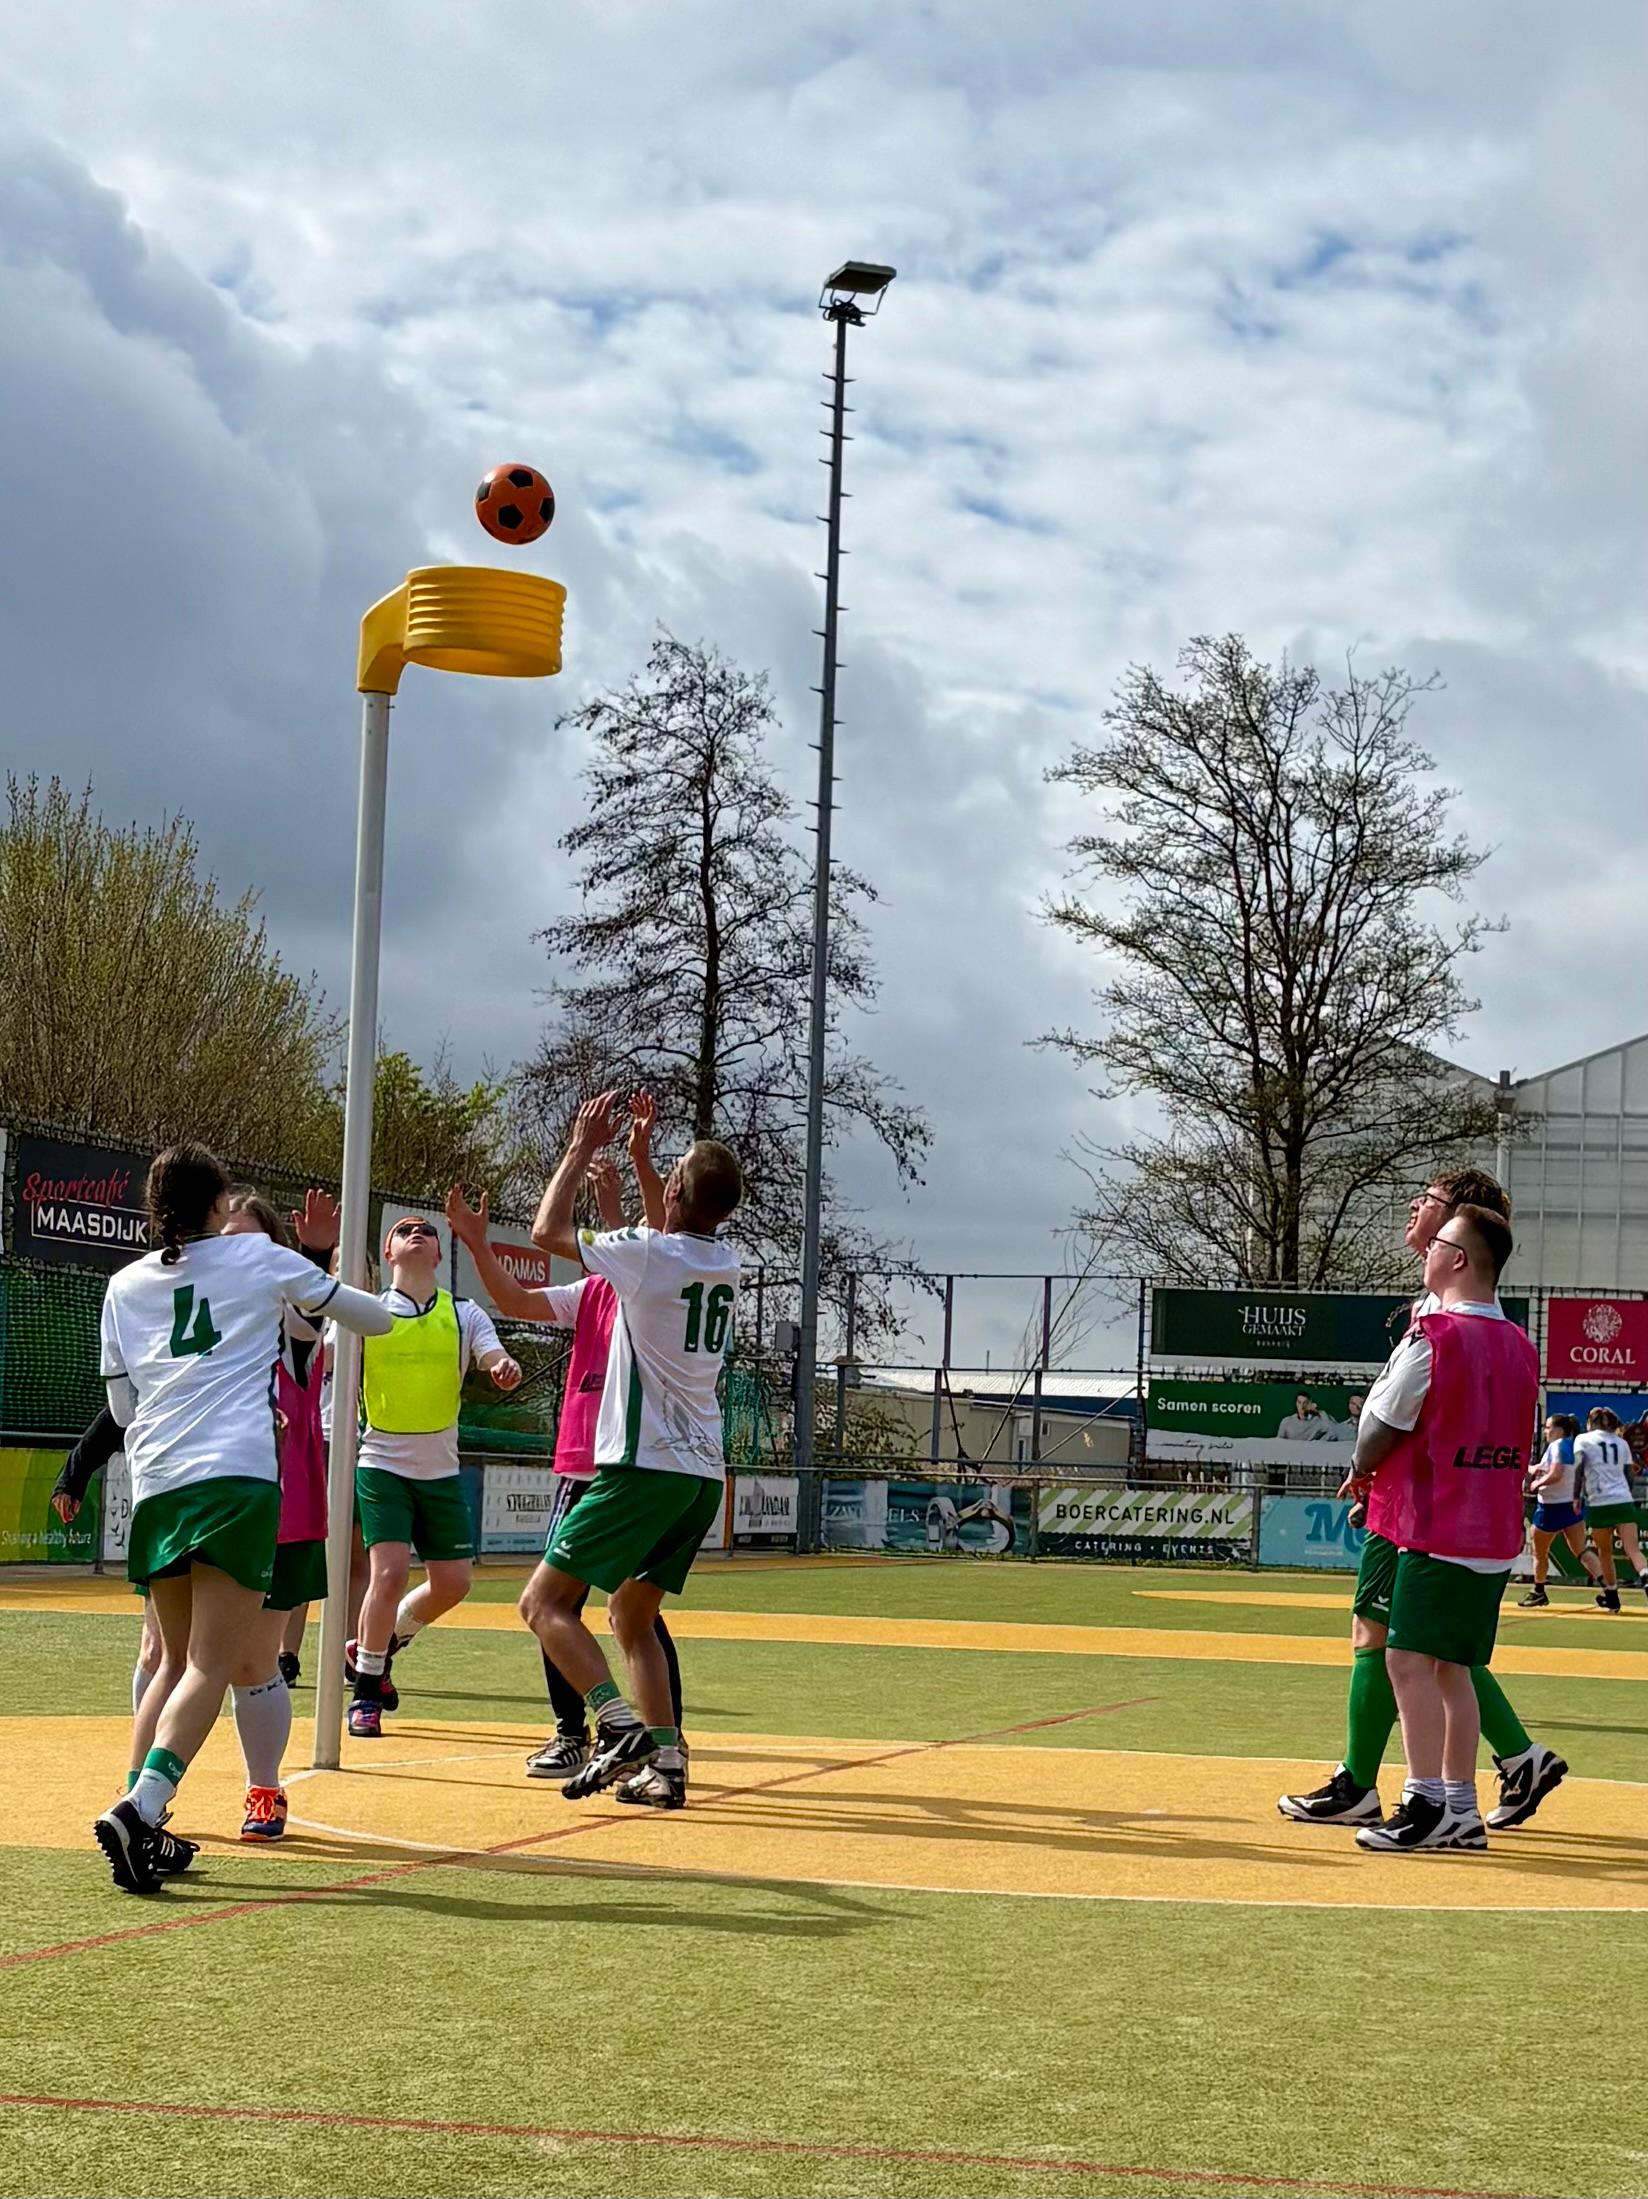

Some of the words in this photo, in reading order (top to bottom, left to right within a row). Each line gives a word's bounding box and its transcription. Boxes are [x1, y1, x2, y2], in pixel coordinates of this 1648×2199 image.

[22, 1168, 131, 1212] Sportcafé
[36, 1206, 150, 1244] MAASDIJK
[170, 1284, 222, 1358] 4
[681, 1281, 735, 1354] 16
[1569, 1346, 1636, 1365] CORAL
[1157, 1397, 1208, 1412] Samen
[1211, 1403, 1262, 1414] scoren
[1598, 1441, 1619, 1465] 11
[1056, 1504, 1236, 1525] BOERCATERING.NL
[1074, 1540, 1142, 1552] CATERING
[1162, 1544, 1214, 1555] EVENTS
